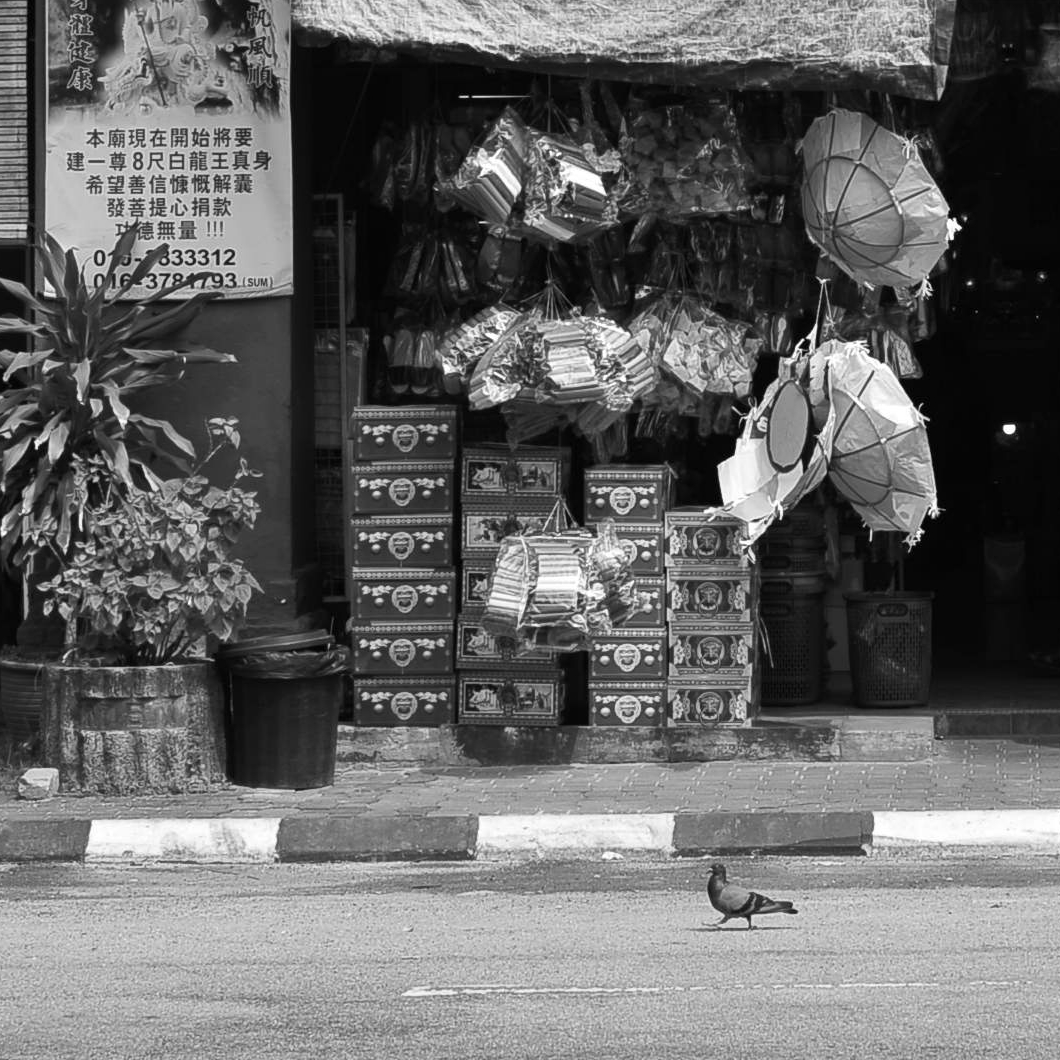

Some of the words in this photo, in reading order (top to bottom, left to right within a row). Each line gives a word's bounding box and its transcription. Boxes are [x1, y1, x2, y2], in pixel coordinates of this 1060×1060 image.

[86, 127, 253, 149] 本廟現在開始將要
[107, 197, 232, 218] 發菩提心捐款
[93, 248, 237, 267] 0-833312
[242, 276, 275, 288] (SUM)
